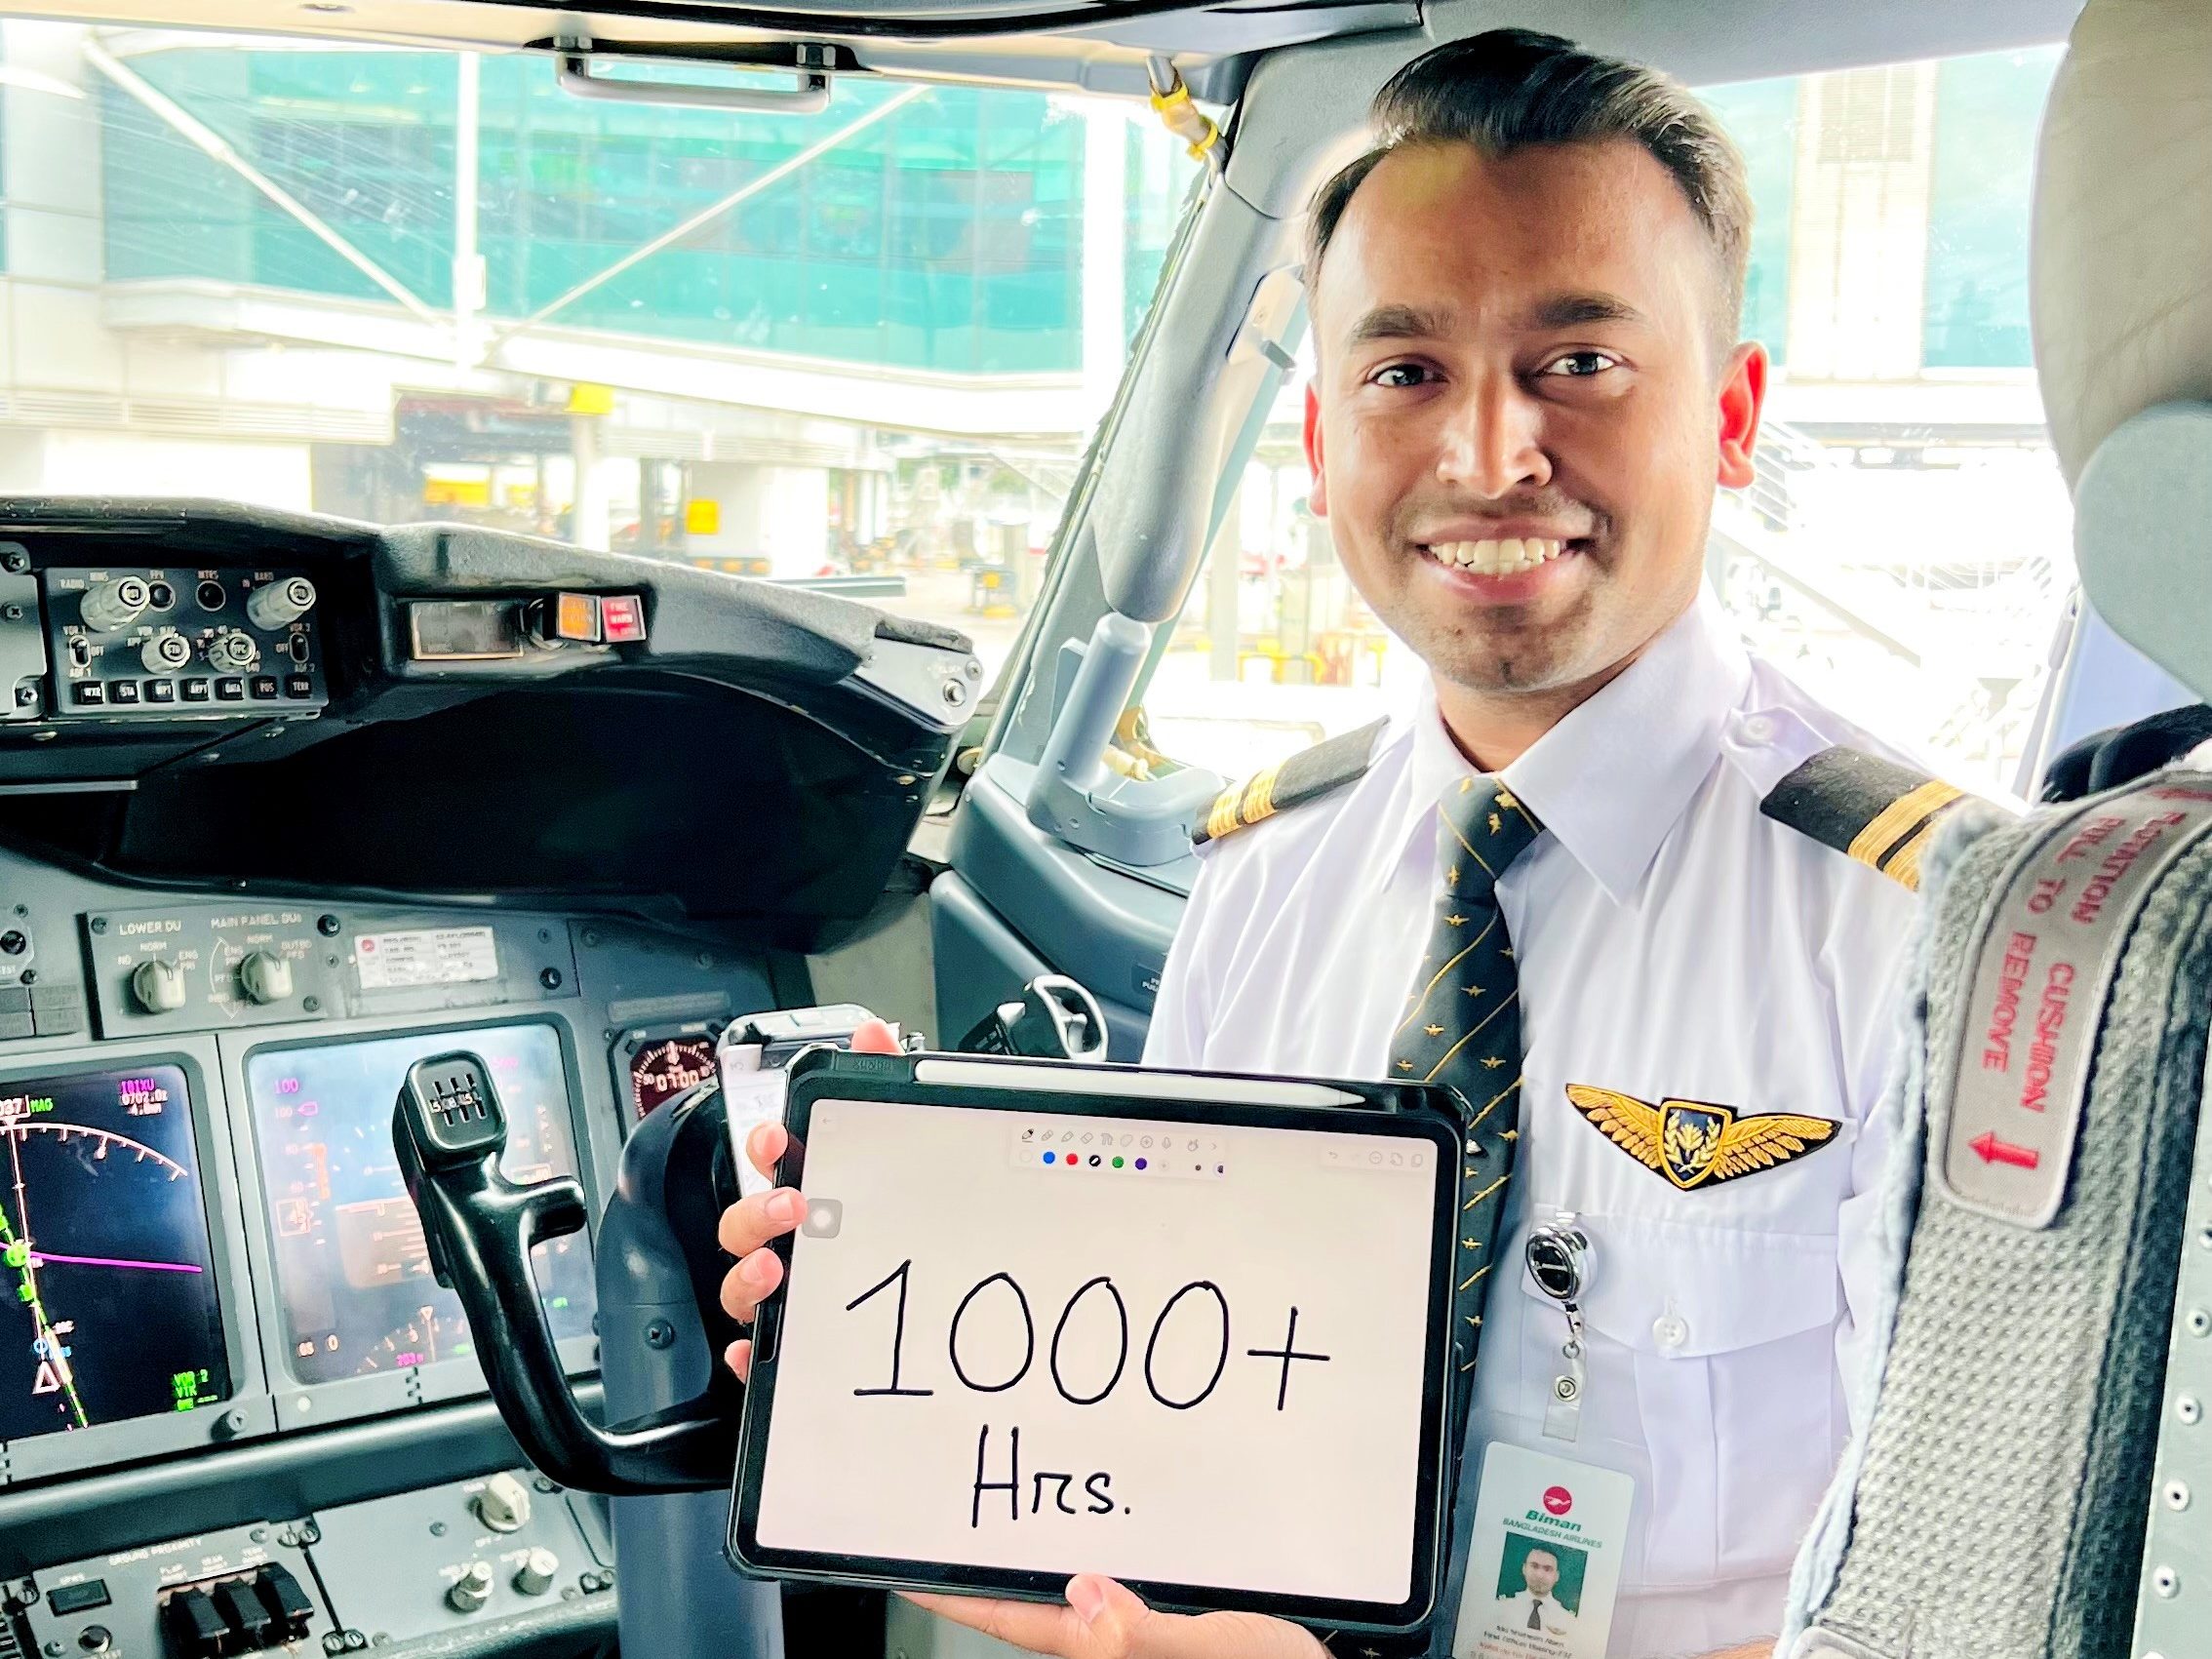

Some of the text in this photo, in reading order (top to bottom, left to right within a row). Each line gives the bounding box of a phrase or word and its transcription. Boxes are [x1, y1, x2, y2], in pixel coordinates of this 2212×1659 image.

[2027, 878, 2068, 915] TO
[119, 920, 182, 936] LOWER DU
[210, 917, 239, 929] MAIN
[241, 913, 279, 926] PANEL
[139, 940, 168, 953] NORM
[246, 934, 273, 945] NORM
[178, 950, 199, 962] ENG
[223, 945, 244, 957] ENG
[1981, 930, 2039, 1074] REMOVE
[2019, 961, 2076, 1114] CUSHION
[271, 1077, 299, 1094] 100
[30, 1097, 55, 1113] MAG
[846, 1259, 1331, 1411] 1000+
[971, 1423, 1131, 1528] Hrs.
[1524, 1509, 1582, 1533] Biman
[1502, 1517, 1602, 1550] BANGLADESH AIRLINES
